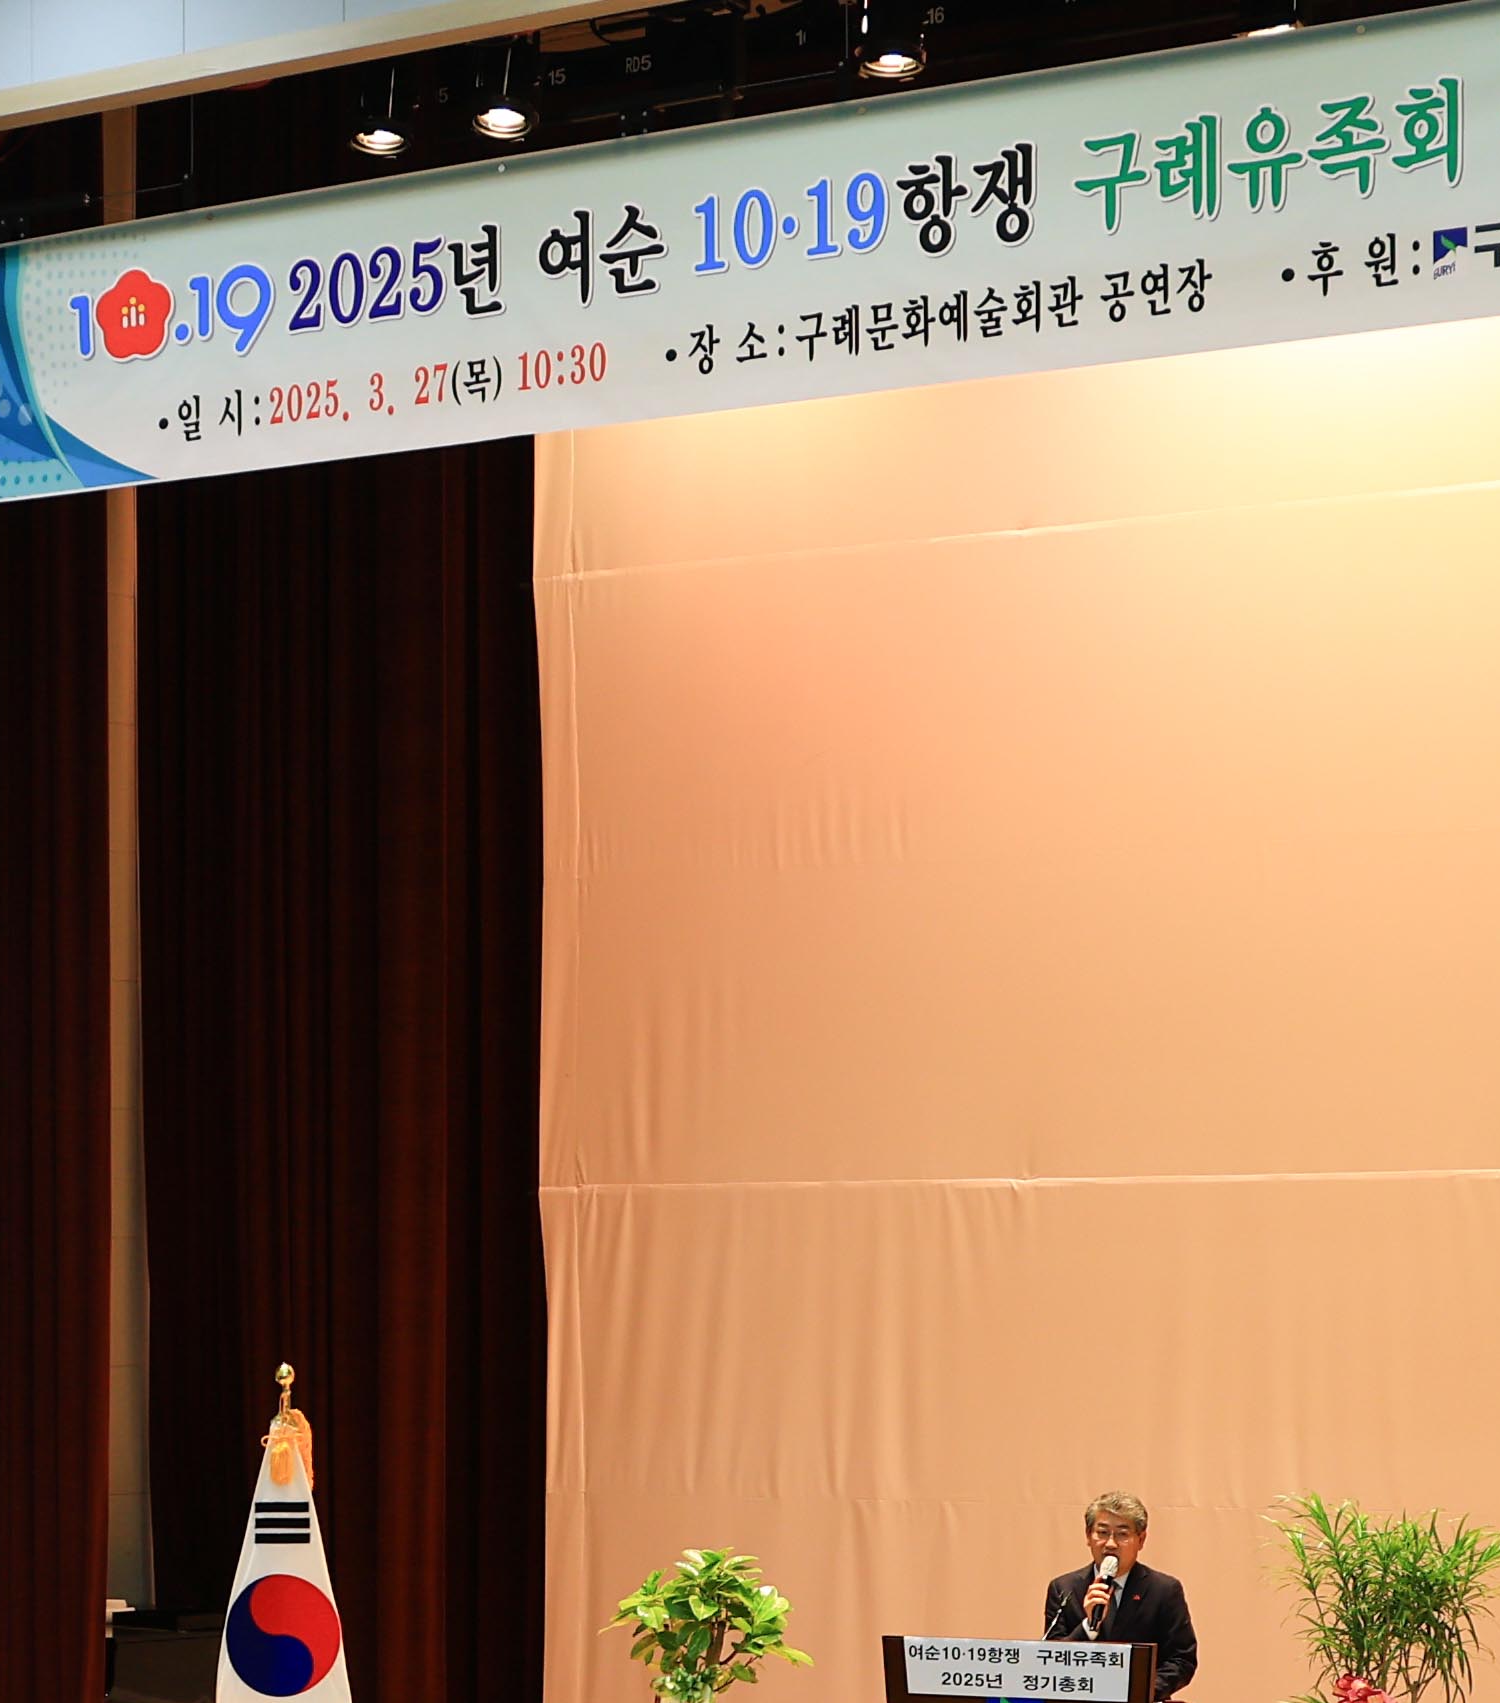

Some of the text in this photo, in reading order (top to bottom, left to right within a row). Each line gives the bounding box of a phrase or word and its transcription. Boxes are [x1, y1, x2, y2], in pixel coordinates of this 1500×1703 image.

[288, 223, 504, 334] 2025년
[537, 204, 665, 304] 여순
[1074, 76, 1463, 231] 구례유족회
[1100, 258, 1213, 323] 공연장
[414, 355, 502, 406] 27(목)
[517, 342, 607, 391] 10:30
[908, 1644, 1125, 1669] 여순10·19항쟁 구례유족회
[941, 1672, 1093, 1693] 2025년 정기총회
